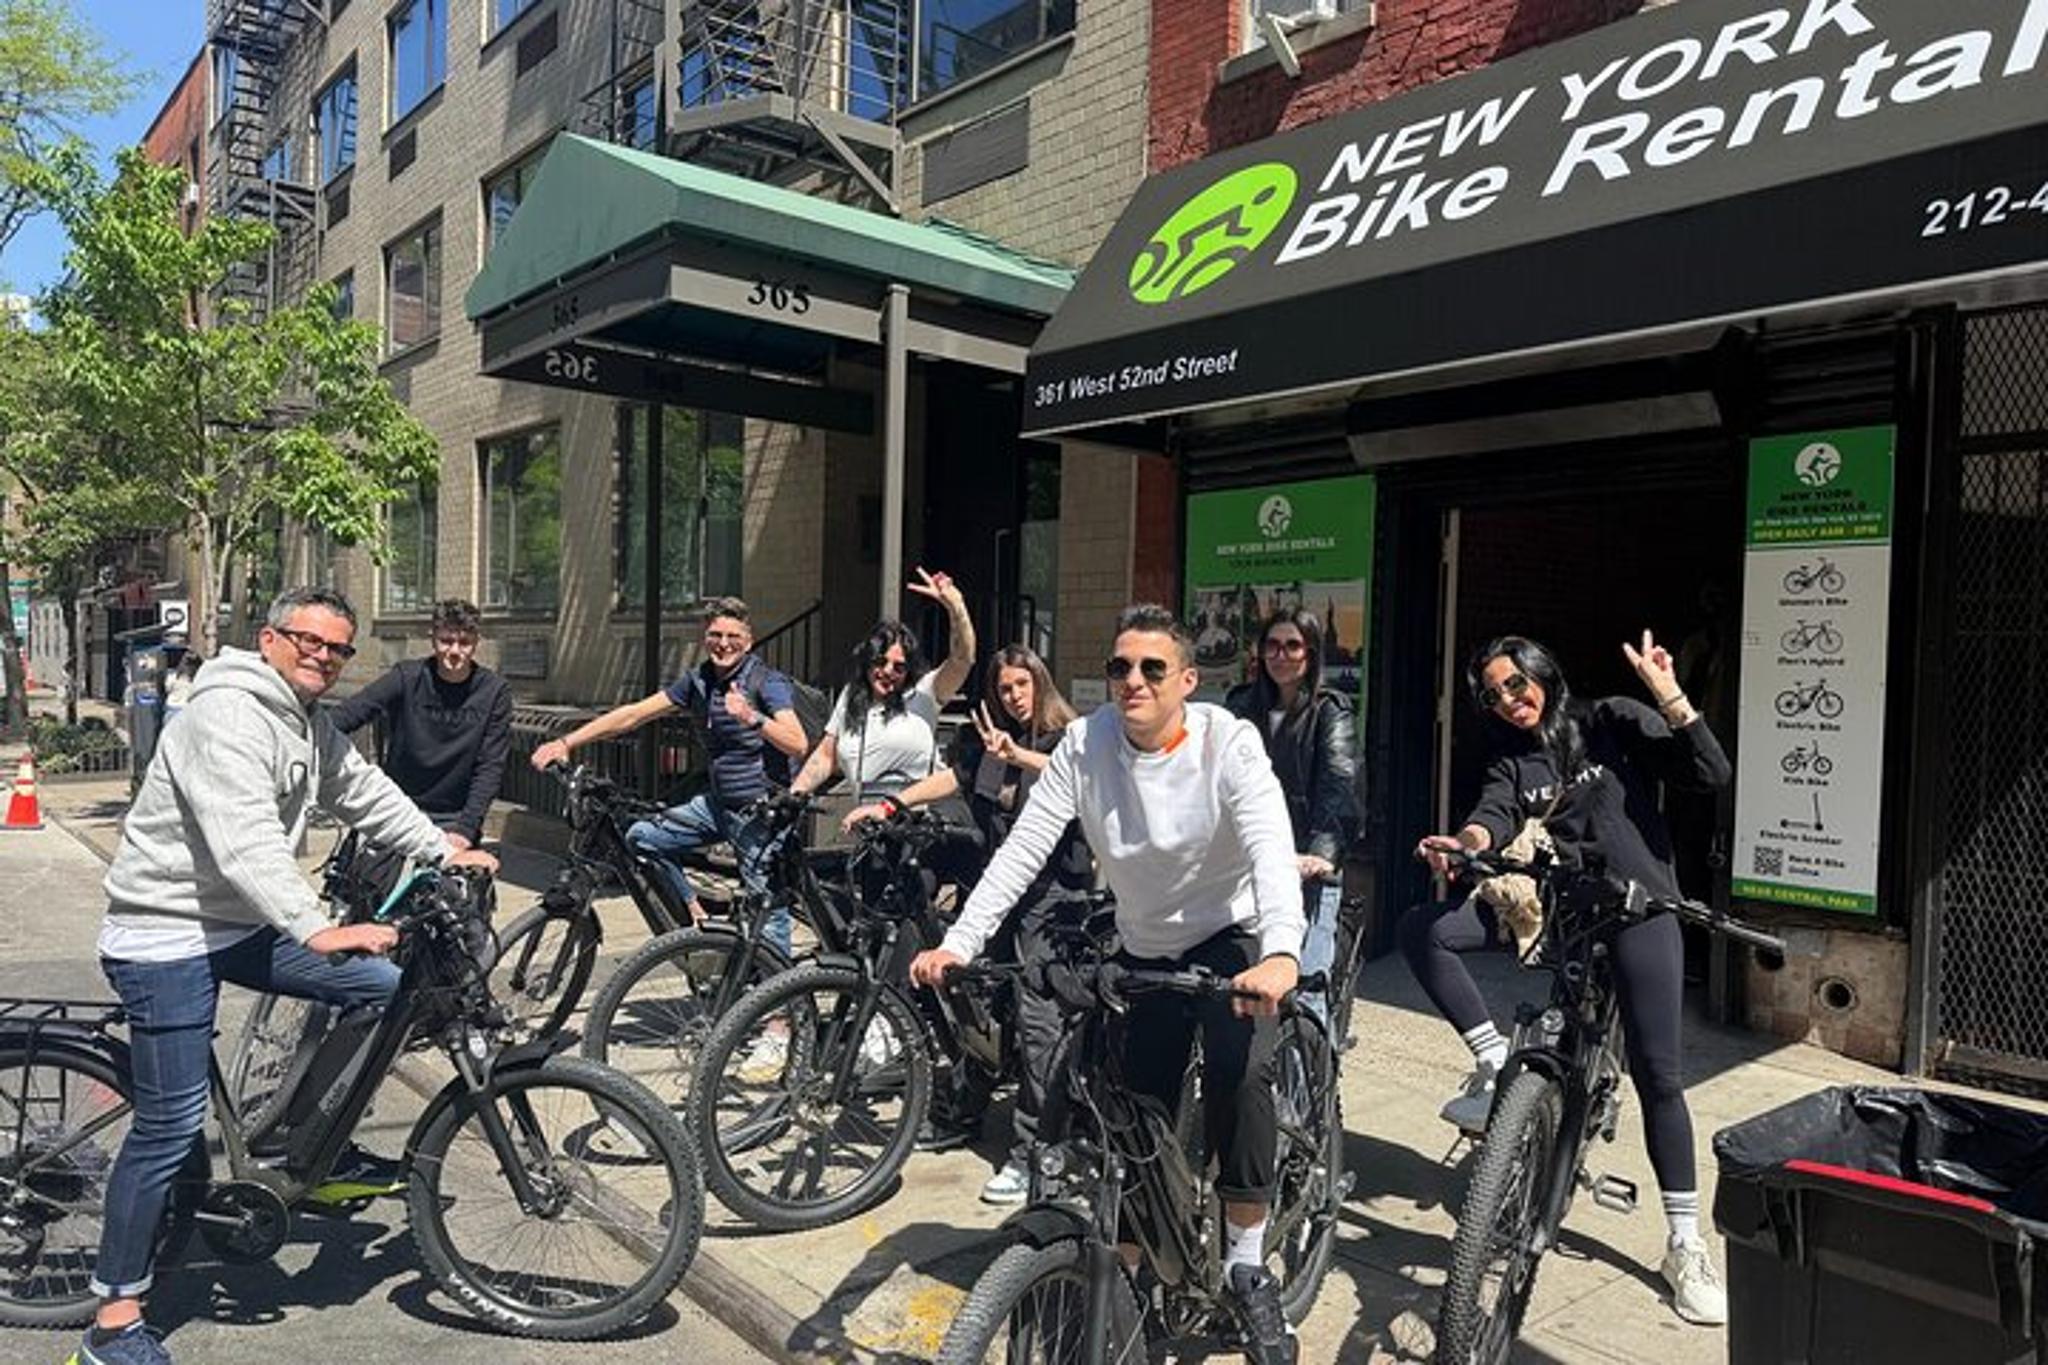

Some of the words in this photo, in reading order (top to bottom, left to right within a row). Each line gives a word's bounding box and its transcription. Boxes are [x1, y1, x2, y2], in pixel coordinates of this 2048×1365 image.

[1318, 87, 1537, 192] NEW
[1561, 0, 1875, 122] YORK
[1274, 166, 1509, 265] Bike
[747, 274, 810, 315] 365
[1034, 381, 1065, 407] 361
[1069, 372, 1116, 398] West
[1119, 360, 1170, 390] 52nd
[1172, 349, 1238, 381] Street
[1777, 721, 1815, 731] Electric
[1820, 722, 1841, 731] Bike
[1760, 830, 1798, 842] Electric
